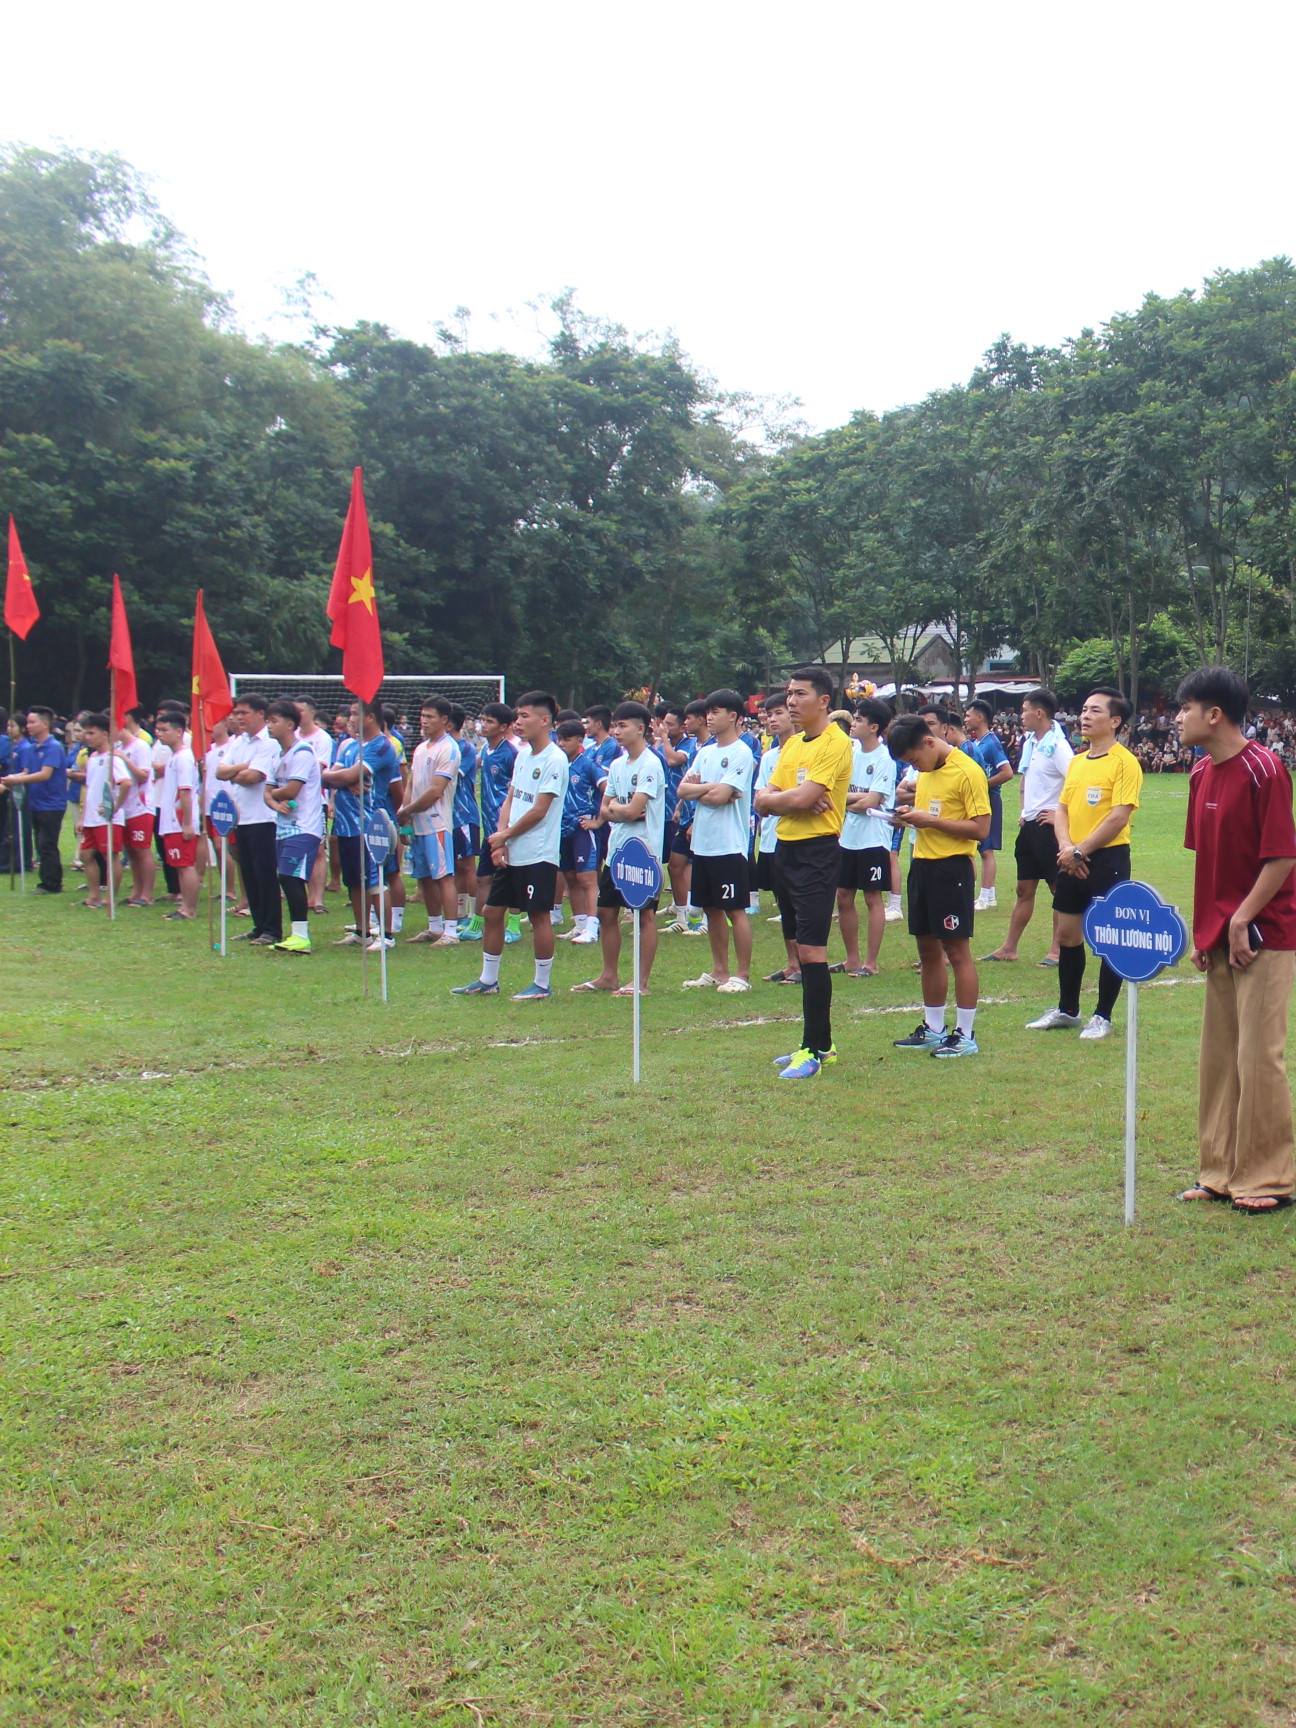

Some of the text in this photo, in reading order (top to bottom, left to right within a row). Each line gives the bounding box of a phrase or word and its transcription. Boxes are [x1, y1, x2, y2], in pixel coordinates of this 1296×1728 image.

[625, 864, 644, 886] TRỌNG
[870, 866, 882, 881] 20
[527, 884, 534, 900] 9
[721, 883, 735, 899] 21
[1115, 906, 1150, 925] ĐƠN VỊ
[1094, 923, 1173, 956] THÔN LƯƠNG NỘI
